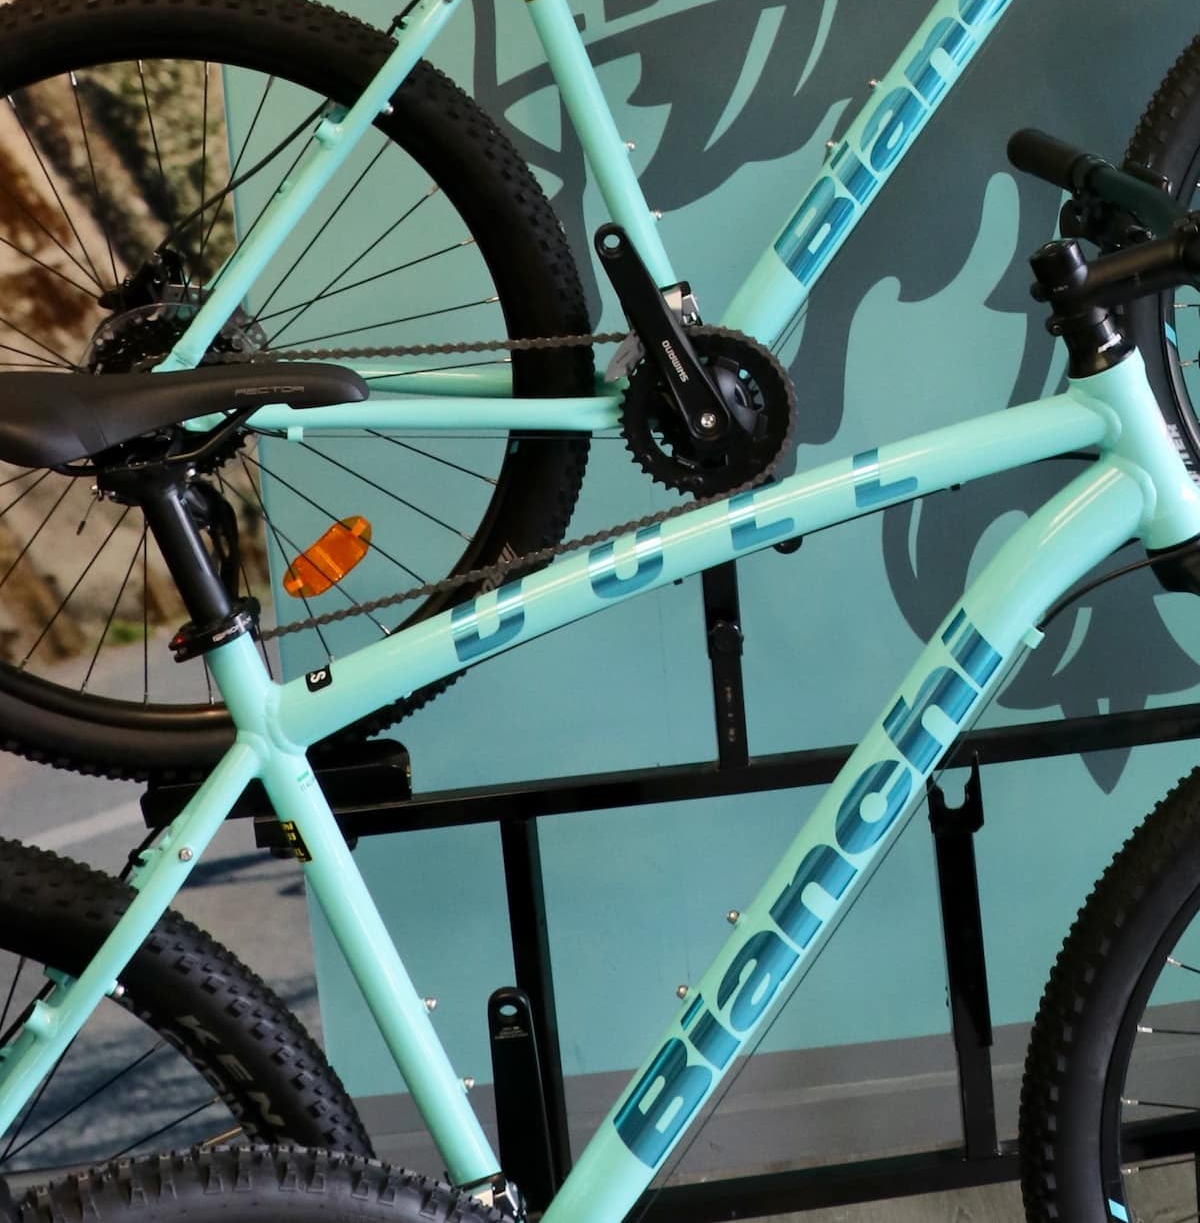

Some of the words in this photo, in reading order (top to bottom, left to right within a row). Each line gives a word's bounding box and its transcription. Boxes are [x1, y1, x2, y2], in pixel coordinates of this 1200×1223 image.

[661, 339, 690, 384] SHIMANO
[612, 608, 1004, 1170] Bianchi
[173, 1014, 290, 1135] KEN
